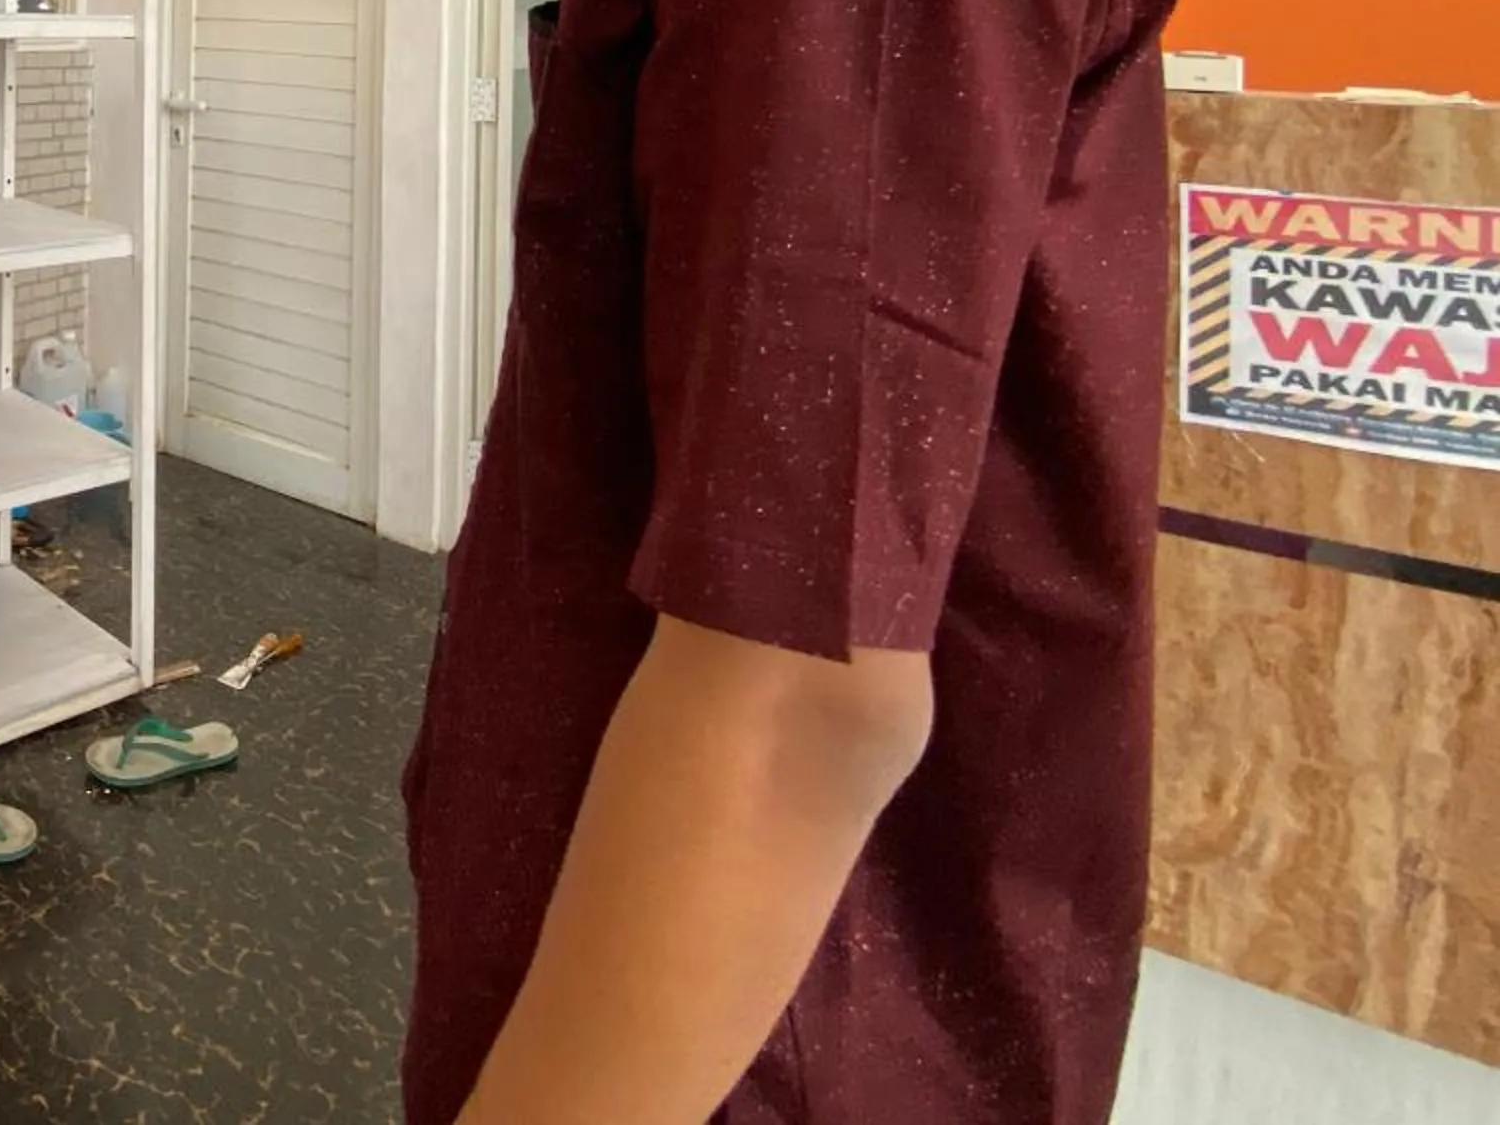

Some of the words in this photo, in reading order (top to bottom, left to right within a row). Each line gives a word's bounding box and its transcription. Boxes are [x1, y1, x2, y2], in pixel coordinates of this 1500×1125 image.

[1249, 255, 1381, 284] ANDA
[1249, 277, 1500, 331] KAWA
[1249, 364, 1406, 403] PAKAI
[1426, 386, 1500, 416] MA
